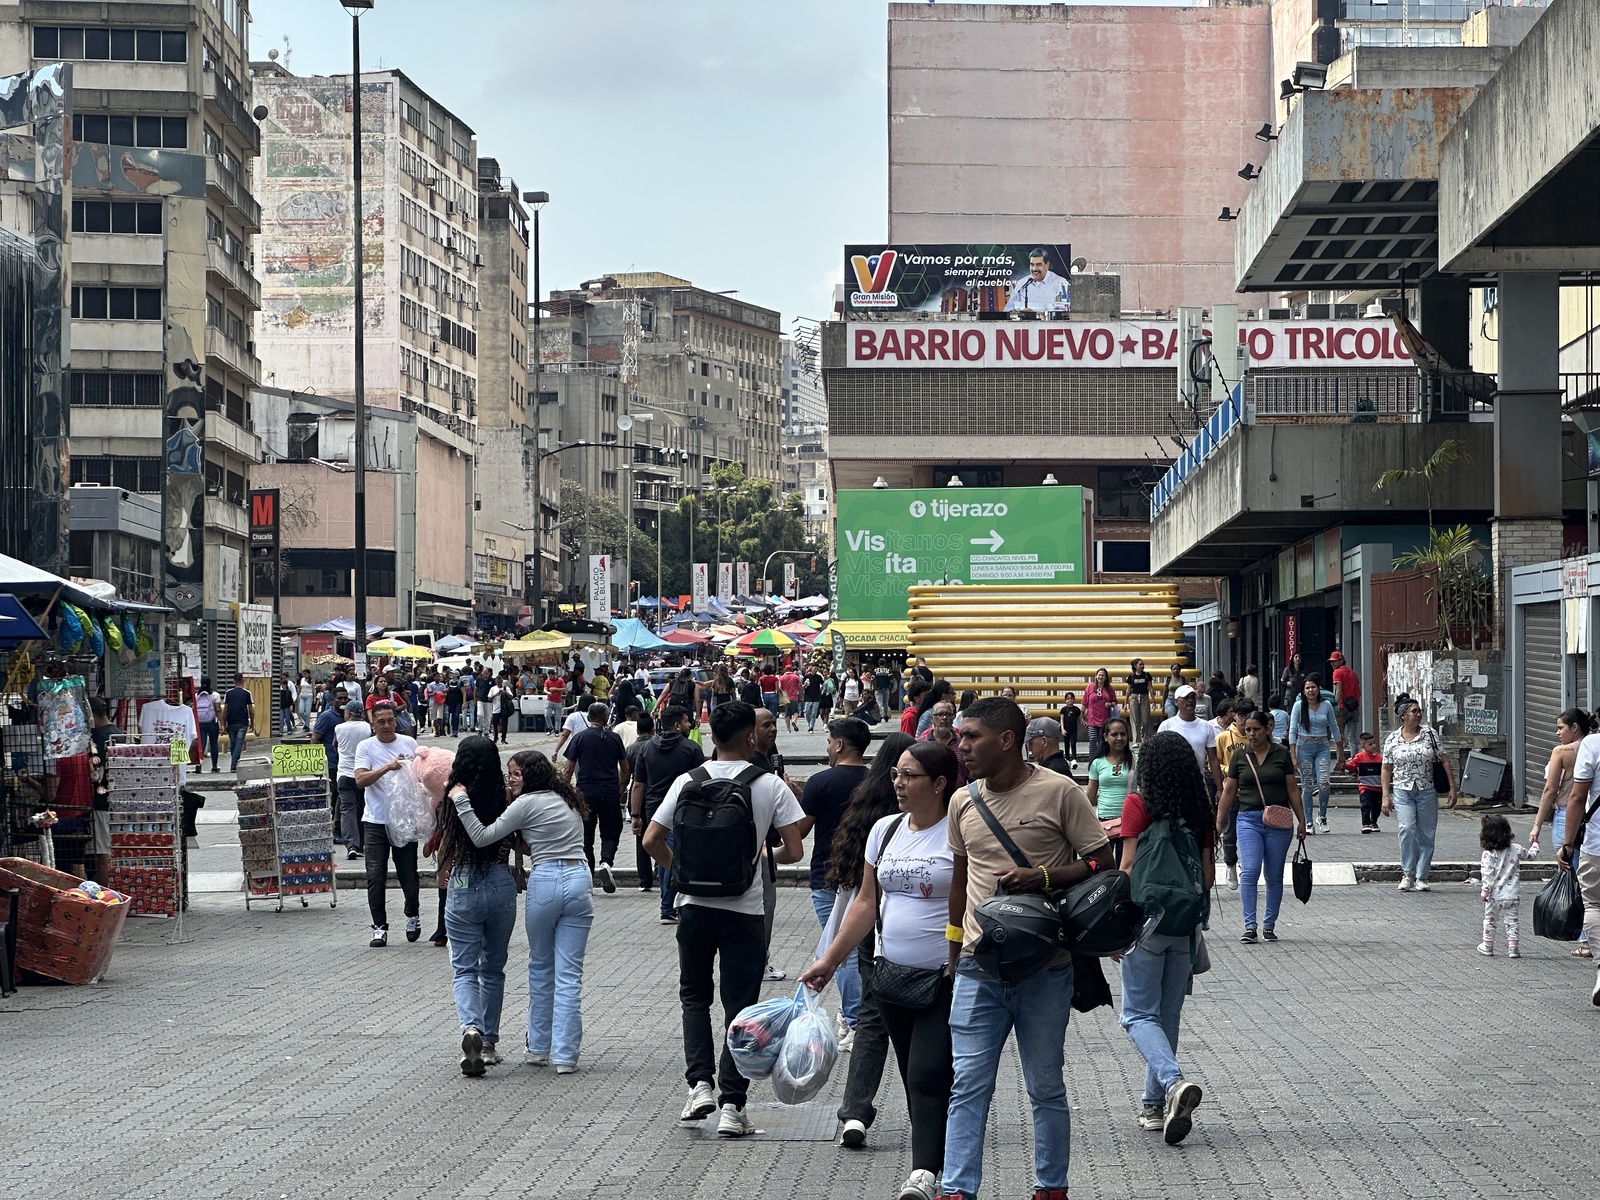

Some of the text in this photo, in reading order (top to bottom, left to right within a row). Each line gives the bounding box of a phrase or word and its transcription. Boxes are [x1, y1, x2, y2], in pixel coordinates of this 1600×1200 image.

[954, 256, 979, 267] por
[981, 253, 1016, 266] más,
[944, 267, 1013, 277] siempre junto
[965, 279, 975, 287] al
[852, 292, 896, 301] Gran Misión
[854, 328, 986, 361] BARRIO
[995, 328, 1115, 361] NUEVO
[252, 495, 273, 526] M
[929, 499, 1008, 522] tijerazo
[844, 529, 964, 551] Visítanos
[272, 745, 292, 760] Se
